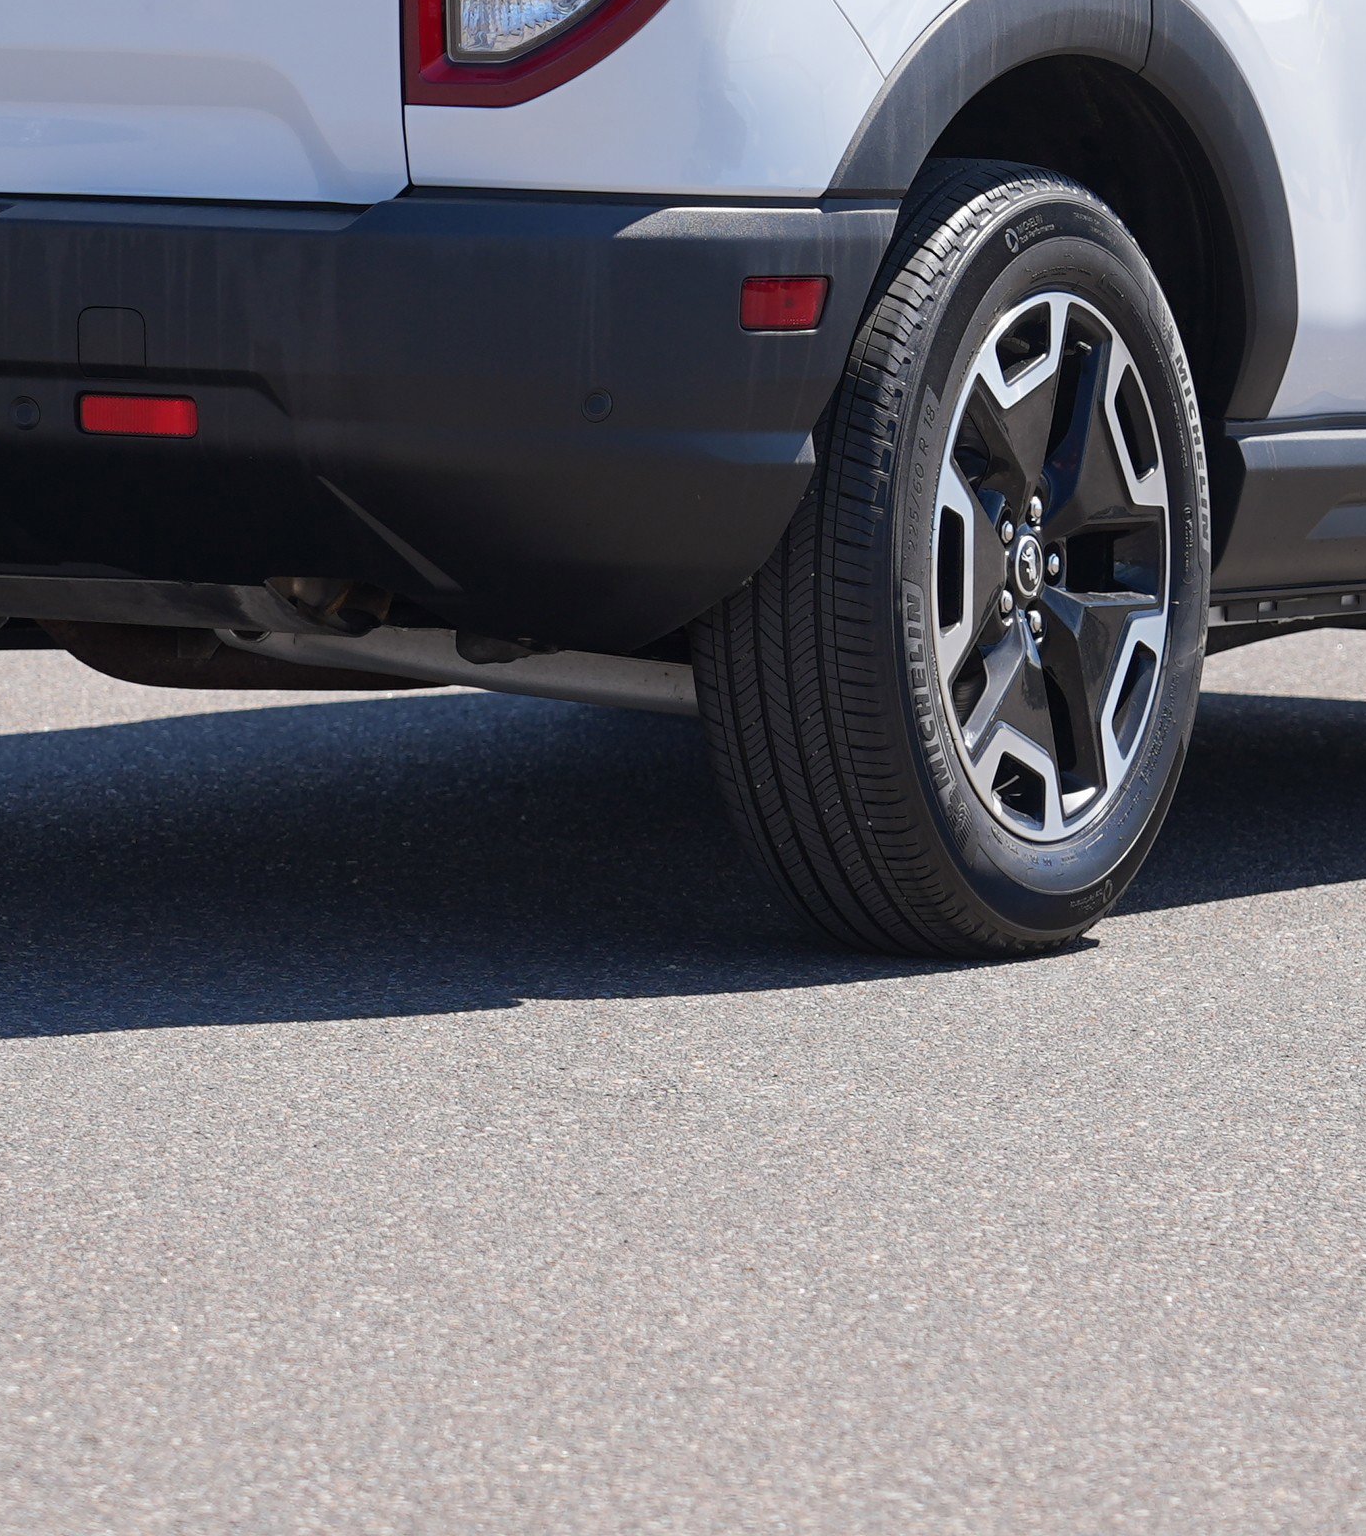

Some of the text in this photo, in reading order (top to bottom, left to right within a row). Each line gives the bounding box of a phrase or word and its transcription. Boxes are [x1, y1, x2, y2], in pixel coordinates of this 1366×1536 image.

[906, 462, 925, 550] 225/60
[923, 403, 936, 430] 18
[1174, 352, 1210, 542] MICHELIN
[905, 592, 951, 792] MICHELIN
